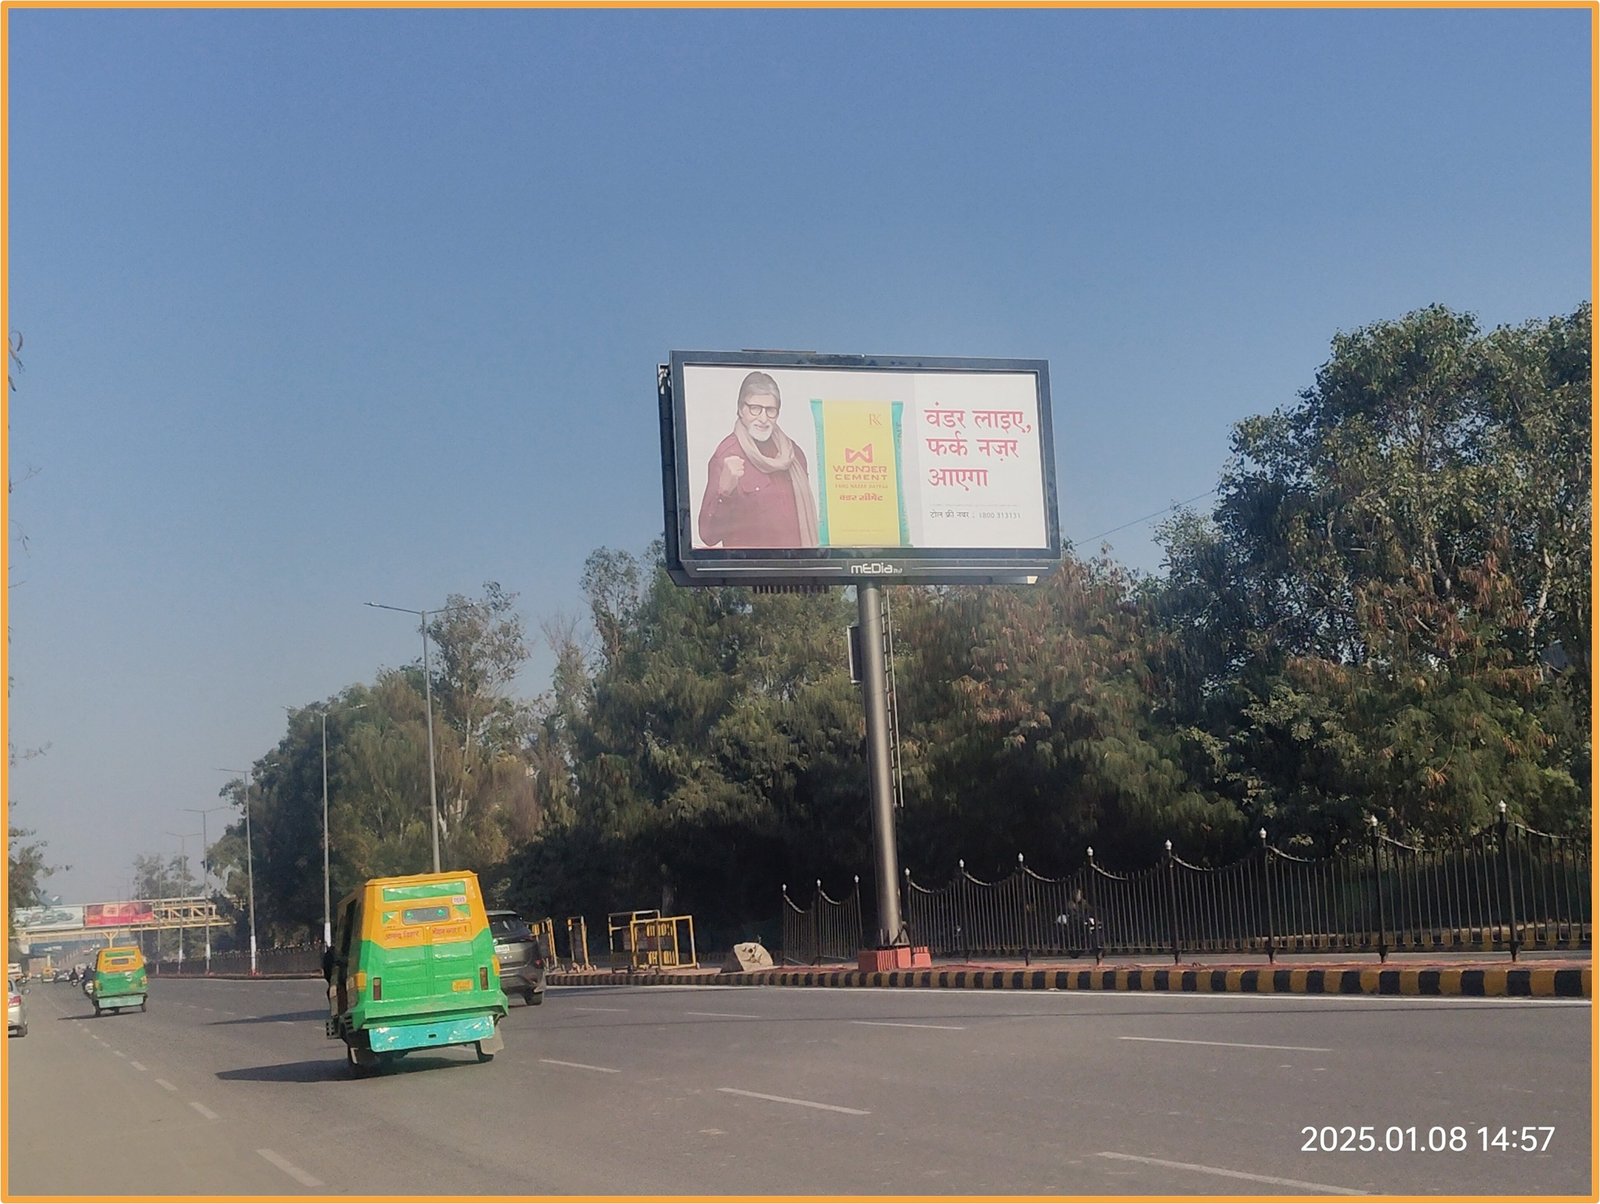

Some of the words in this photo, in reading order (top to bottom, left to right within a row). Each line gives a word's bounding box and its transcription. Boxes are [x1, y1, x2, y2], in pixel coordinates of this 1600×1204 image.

[924, 401, 966, 429] वंडर
[972, 409, 1031, 433] लाइए,
[925, 430, 968, 456] फर्क
[976, 439, 1019, 461] नज़र
[832, 465, 887, 473] WONDER
[928, 468, 988, 491] आएगा
